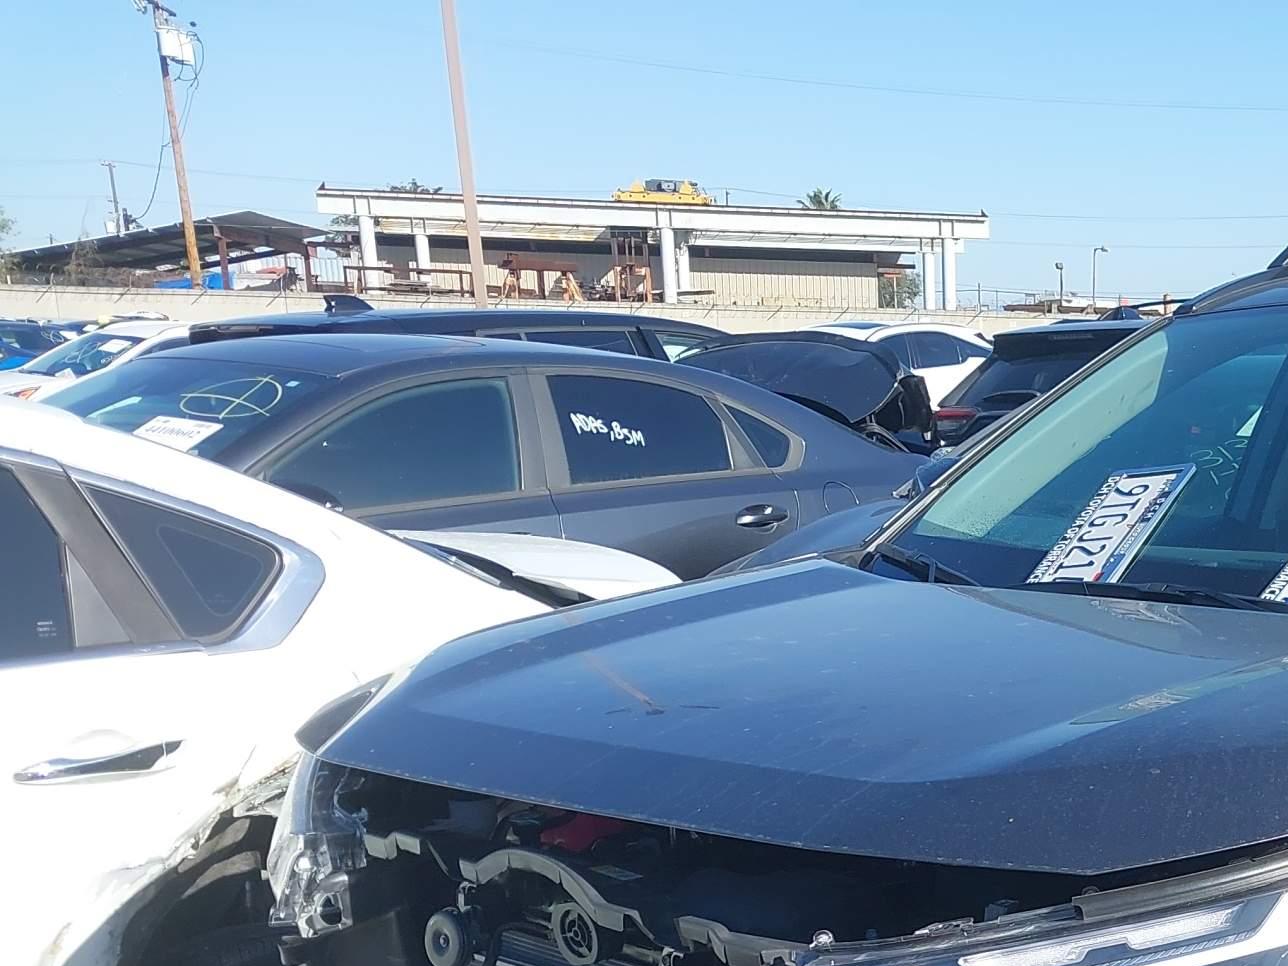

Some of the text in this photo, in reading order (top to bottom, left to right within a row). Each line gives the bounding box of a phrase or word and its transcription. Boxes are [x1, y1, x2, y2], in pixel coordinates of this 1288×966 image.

[1024, 476, 1121, 583] DCH TOYOTA OF TORRANCE
